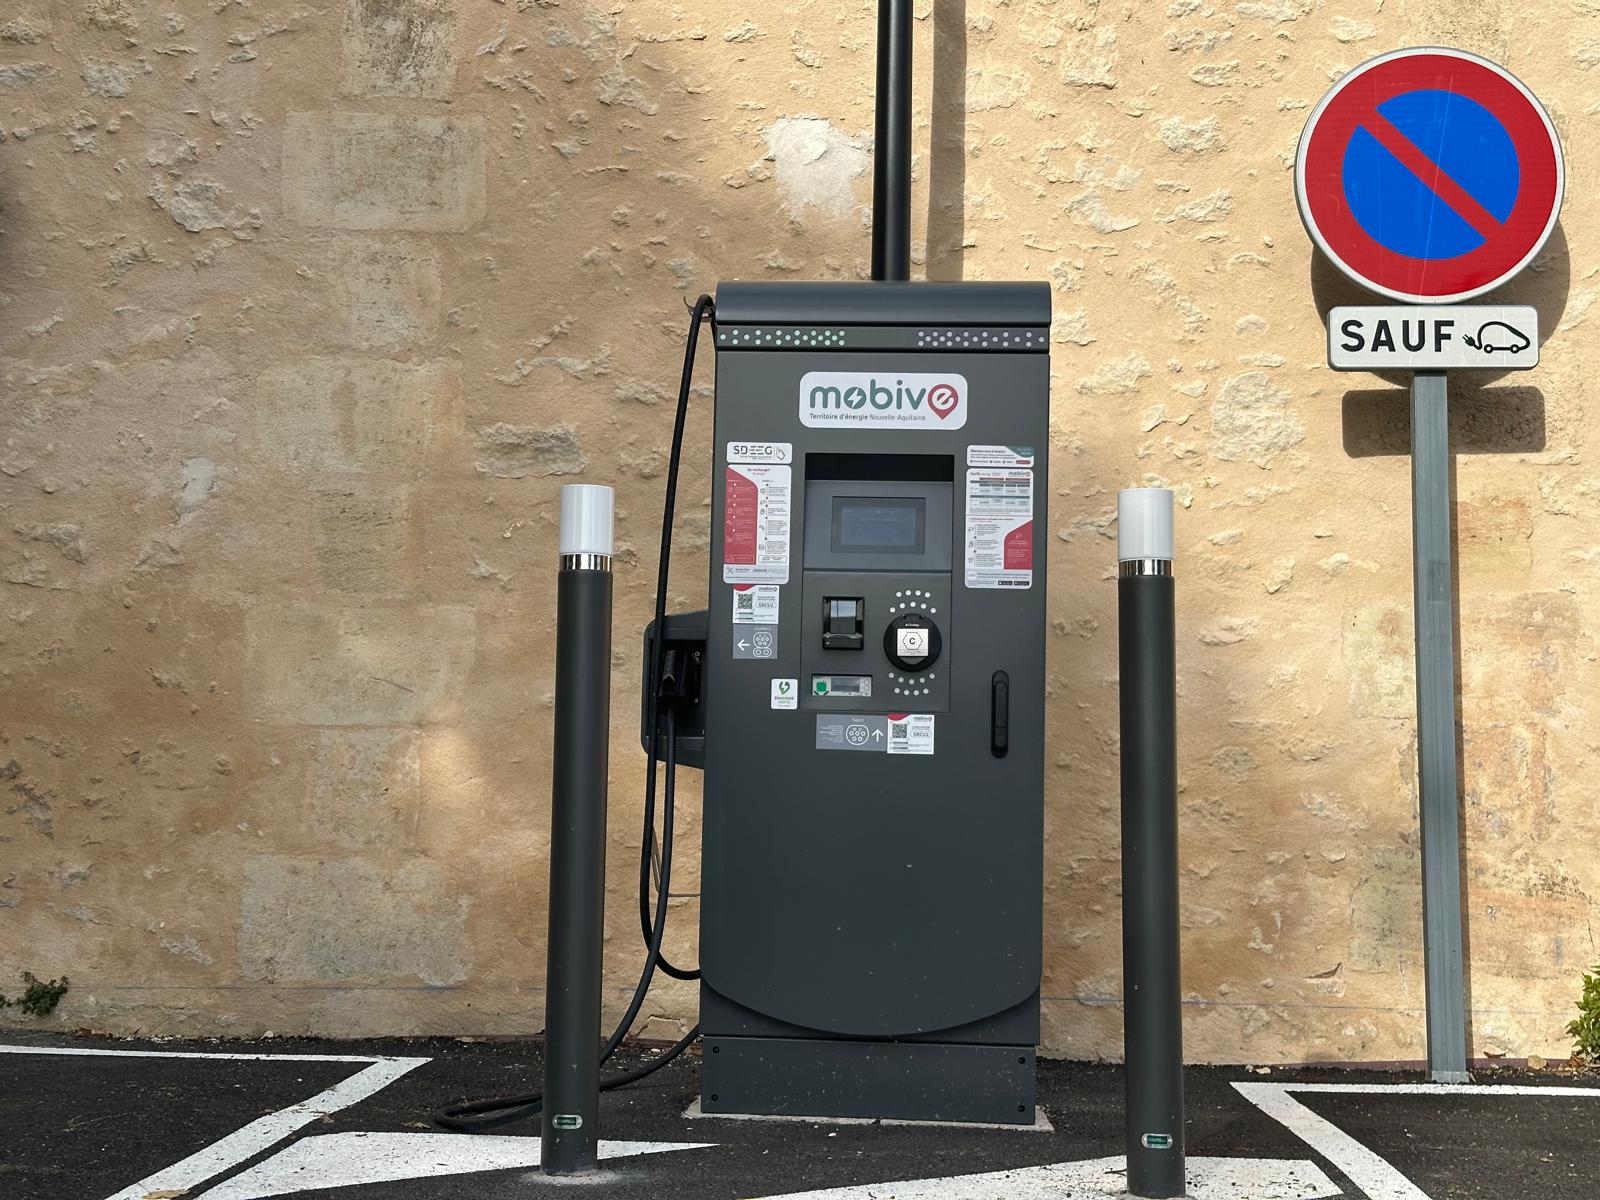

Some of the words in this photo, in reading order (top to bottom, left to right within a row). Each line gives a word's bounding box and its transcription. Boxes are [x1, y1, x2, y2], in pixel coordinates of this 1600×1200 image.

[1341, 319, 1455, 353] SAUF
[809, 378, 959, 420] mobive
[809, 412, 838, 420] Territoire
[839, 412, 869, 422] d'énergie
[869, 413, 926, 423] Nouvelle-Aquitaine
[909, 637, 916, 645] C
